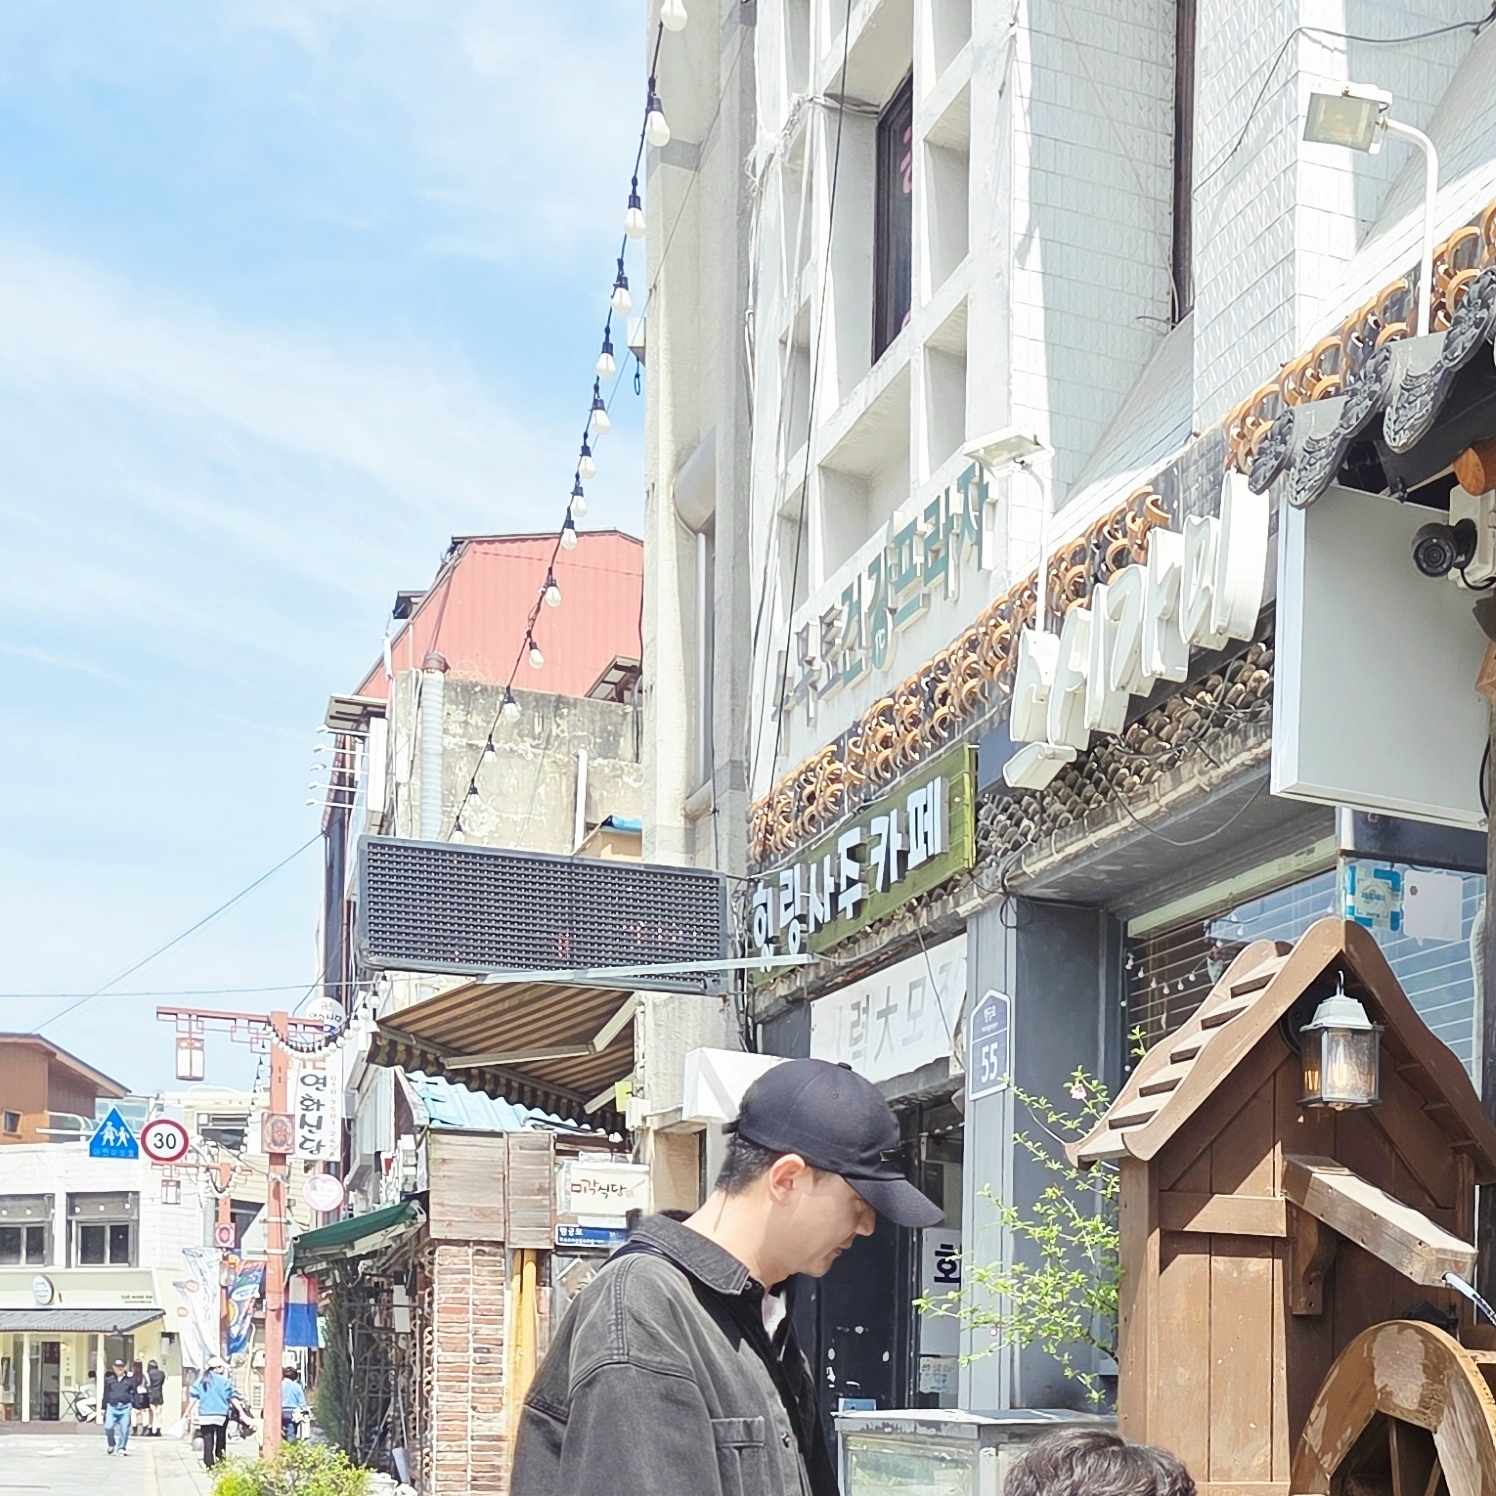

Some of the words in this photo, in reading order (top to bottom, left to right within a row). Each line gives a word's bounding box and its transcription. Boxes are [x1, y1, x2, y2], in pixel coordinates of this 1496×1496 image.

[981, 1042, 998, 1083] 55
[299, 1073, 327, 1155] 연화신당
[153, 1132, 177, 1150] 30
[570, 1179, 628, 1199] 미각식당
